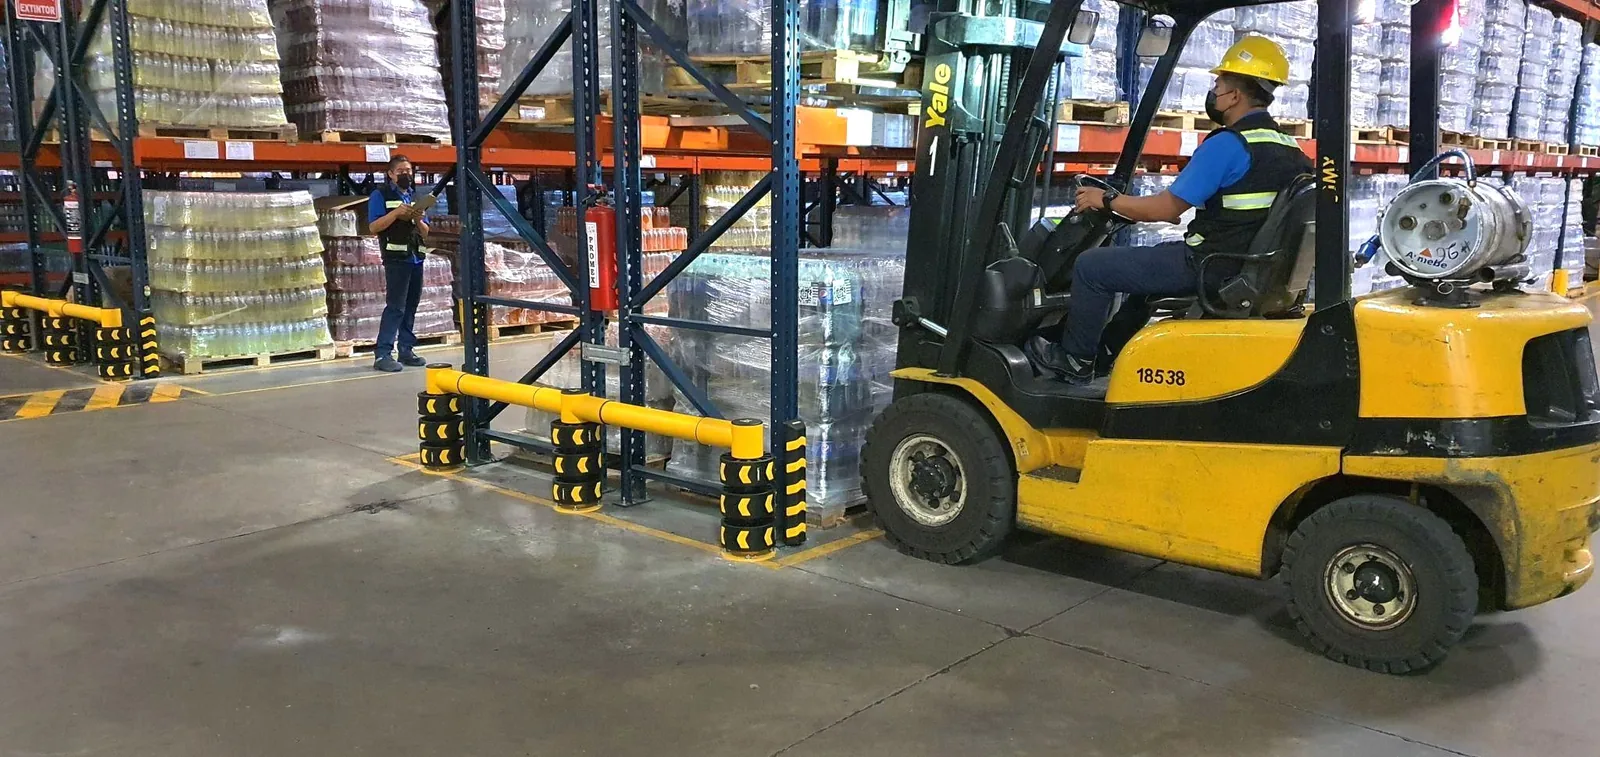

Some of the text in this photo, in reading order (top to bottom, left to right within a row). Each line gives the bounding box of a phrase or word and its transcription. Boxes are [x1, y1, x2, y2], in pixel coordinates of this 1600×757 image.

[20, 3, 56, 15] EXTINTOR
[925, 63, 951, 128] Yale
[929, 135, 938, 177] 1
[588, 236, 596, 284] PROMEX
[1136, 367, 1186, 386] 18538
